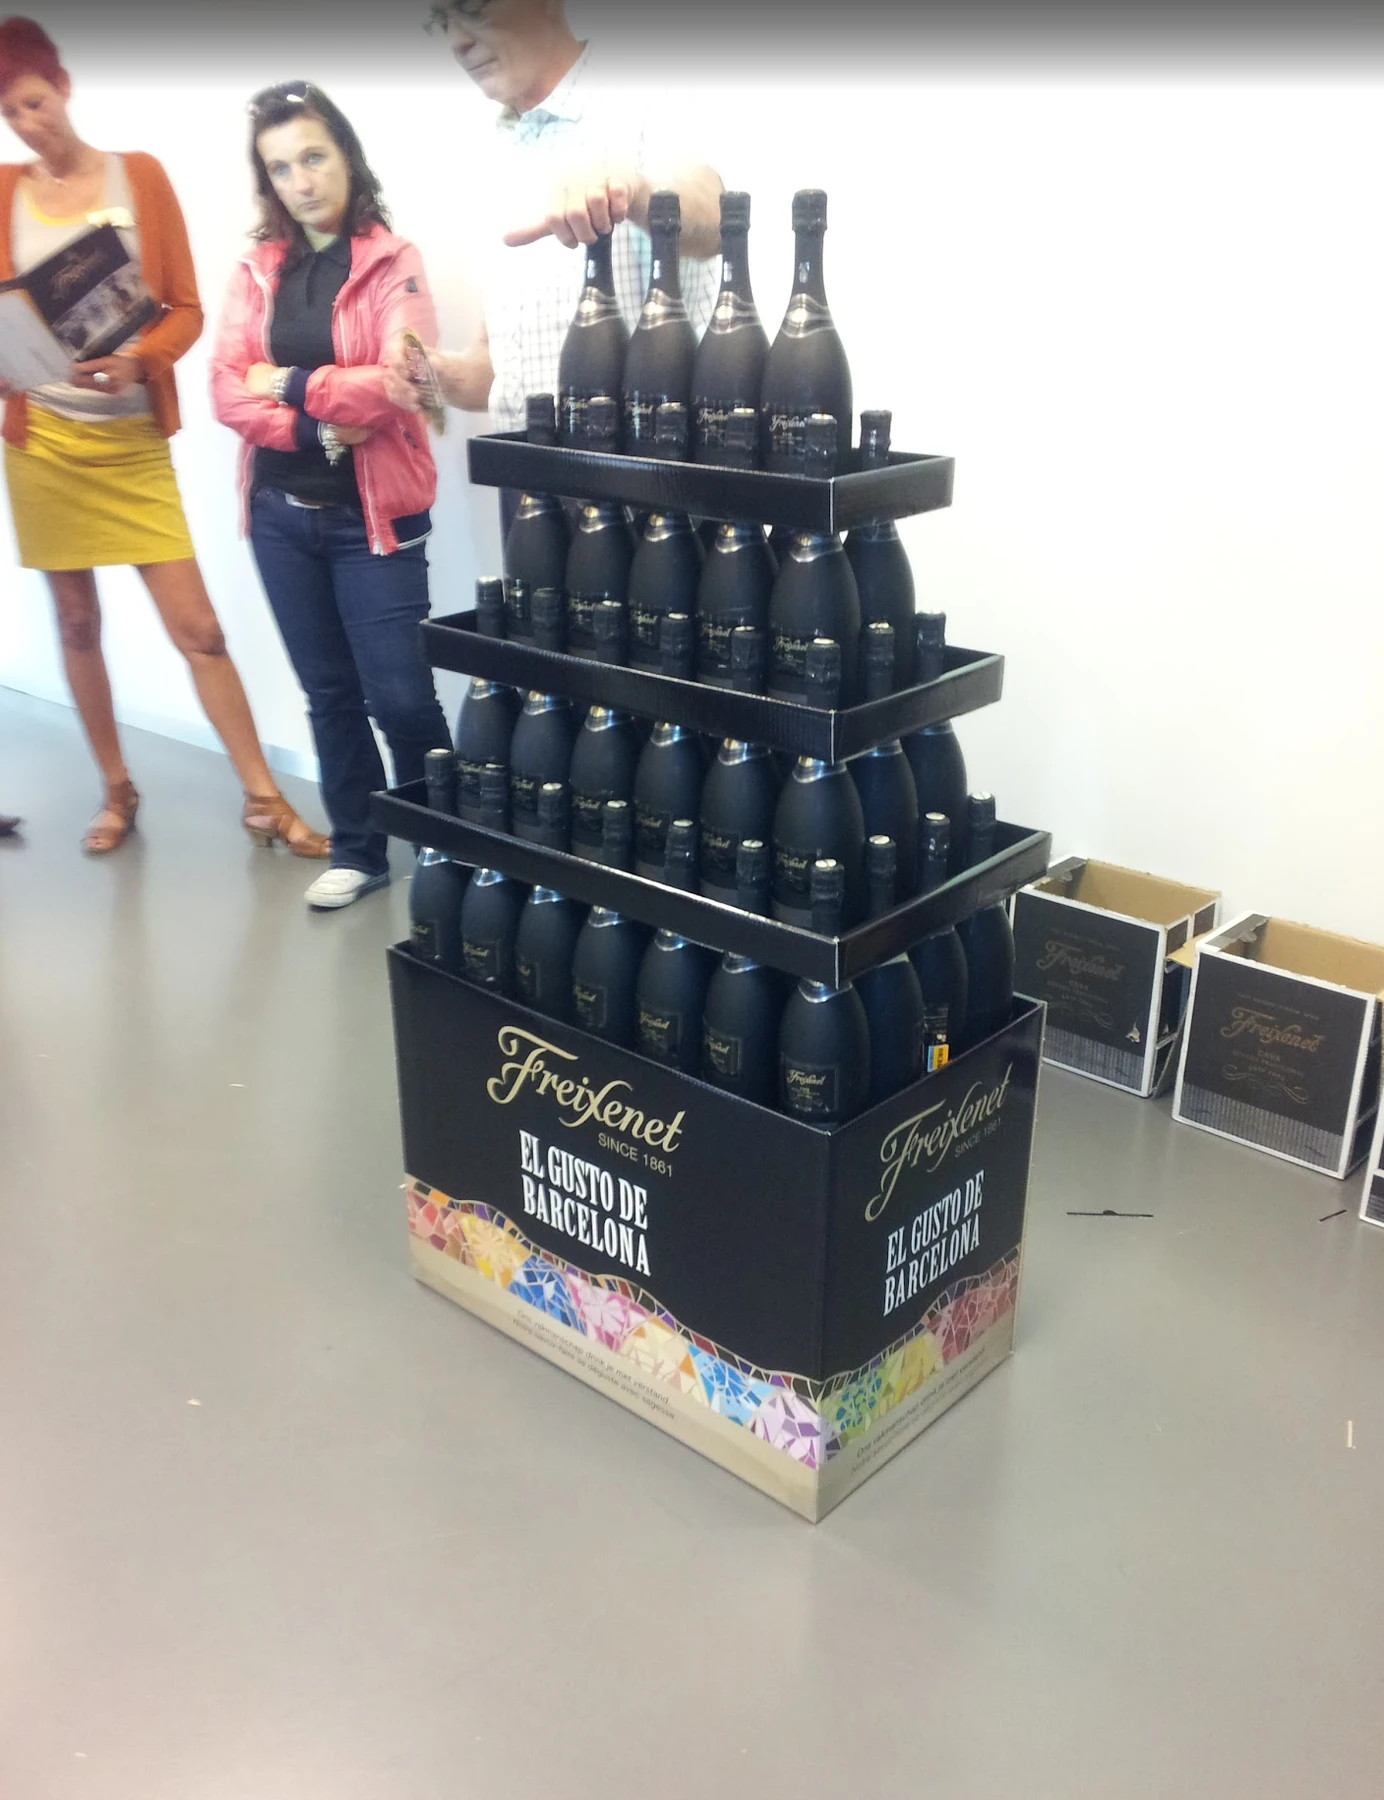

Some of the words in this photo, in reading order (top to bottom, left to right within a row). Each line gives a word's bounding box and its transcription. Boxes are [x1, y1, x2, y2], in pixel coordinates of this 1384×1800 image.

[486, 1025, 687, 1153] Freixenet
[519, 1129, 544, 1180] EL
[547, 1145, 613, 1213] GUSTO
[617, 1177, 648, 1231] DE
[597, 1132, 638, 1162] SINCE
[643, 1153, 673, 1178] 1861
[864, 1062, 1013, 1223] Freixenet
[521, 1173, 651, 1277] BARCELONA
[883, 1213, 981, 1317] BARCELONA
[886, 1227, 907, 1274] EL
[911, 1187, 962, 1255] GUSTO
[963, 1169, 985, 1219] DE
